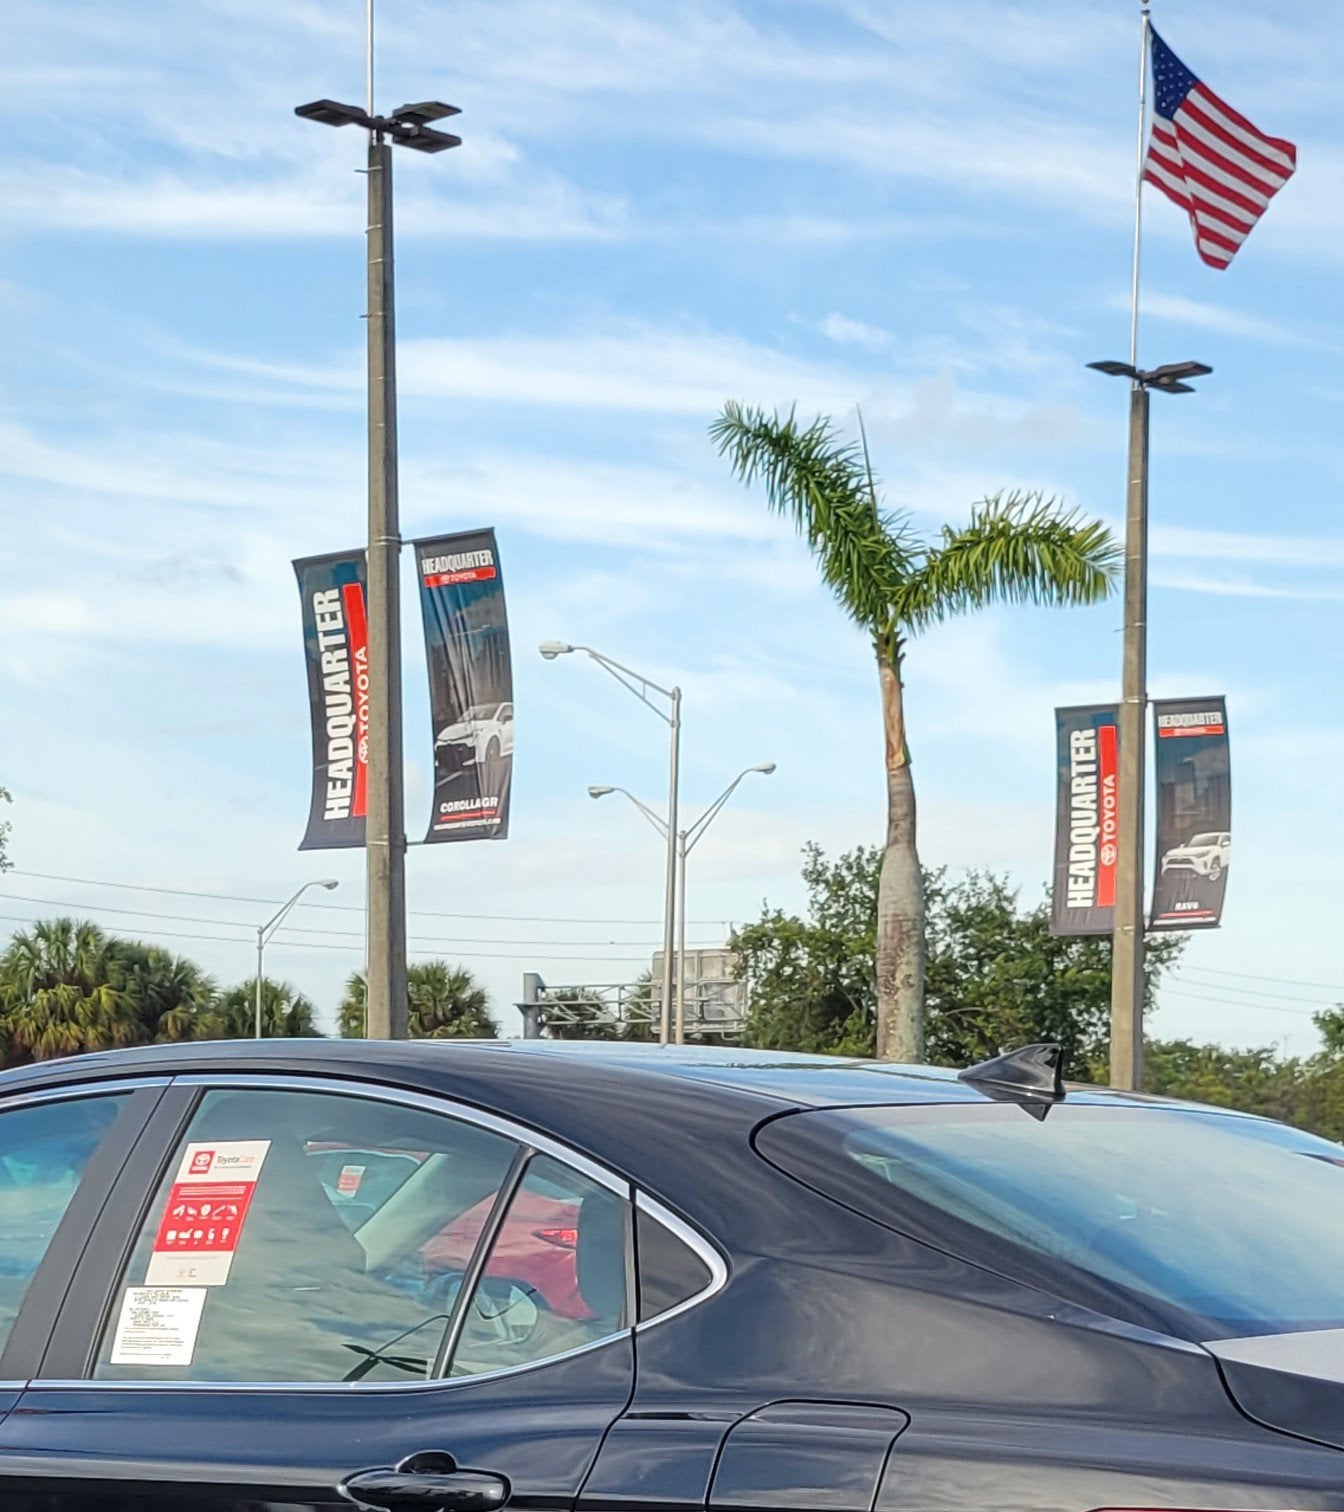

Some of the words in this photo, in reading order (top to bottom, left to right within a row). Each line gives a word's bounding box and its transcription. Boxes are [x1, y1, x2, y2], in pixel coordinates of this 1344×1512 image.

[423, 549, 494, 574] HEADQUARTER
[313, 588, 355, 820] HEADQUARTER
[355, 646, 369, 735] TOYOTA
[1066, 729, 1100, 908] HEADQUARTER
[1102, 774, 1116, 843] TOYOTA
